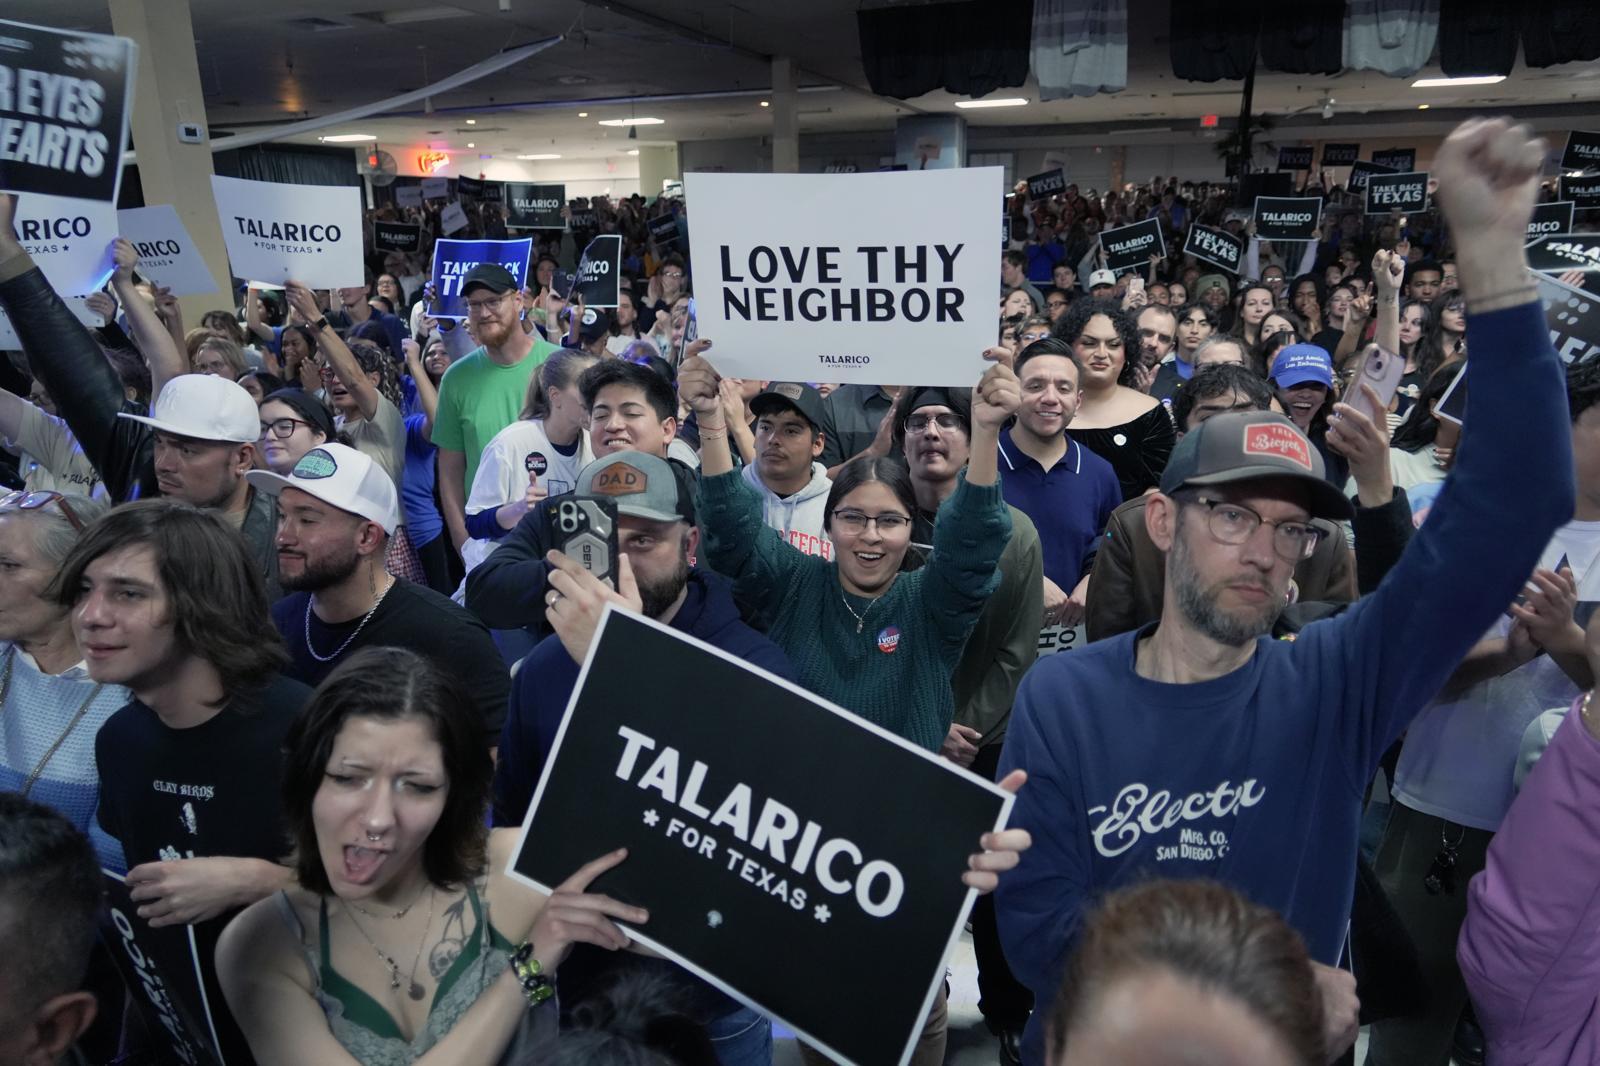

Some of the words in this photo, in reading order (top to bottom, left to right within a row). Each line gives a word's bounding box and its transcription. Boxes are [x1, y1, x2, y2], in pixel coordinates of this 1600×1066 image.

[18, 68, 106, 126] EYES
[0, 117, 109, 178] EARTS
[1372, 190, 1423, 205] TEXAS
[1373, 184, 1397, 194] TAKE
[1398, 182, 1424, 192] BACK
[514, 199, 559, 209] TALARICO
[1262, 212, 1312, 223] TALARICO
[1527, 221, 1560, 233] RICO
[234, 216, 342, 243] TALARICO
[379, 231, 416, 241] TALARICO
[26, 244, 58, 255] EXAS
[261, 241, 277, 251] FOR
[280, 245, 313, 254] TEXAS
[1108, 234, 1155, 253] TALARICO
[1194, 234, 1238, 262] TEXAS
[1545, 242, 1600, 261] TALA
[720, 245, 842, 284] LOVE
[857, 243, 965, 283] THY
[722, 287, 965, 323] NEIGHBOR
[818, 355, 870, 364] TALARICO
[599, 472, 637, 487] DAD
[153, 779, 178, 794] CLAY
[180, 784, 214, 801] BIRDS
[615, 725, 905, 918] TALARICO
[666, 818, 717, 859] FOR
[726, 848, 807, 911] TEXAS
